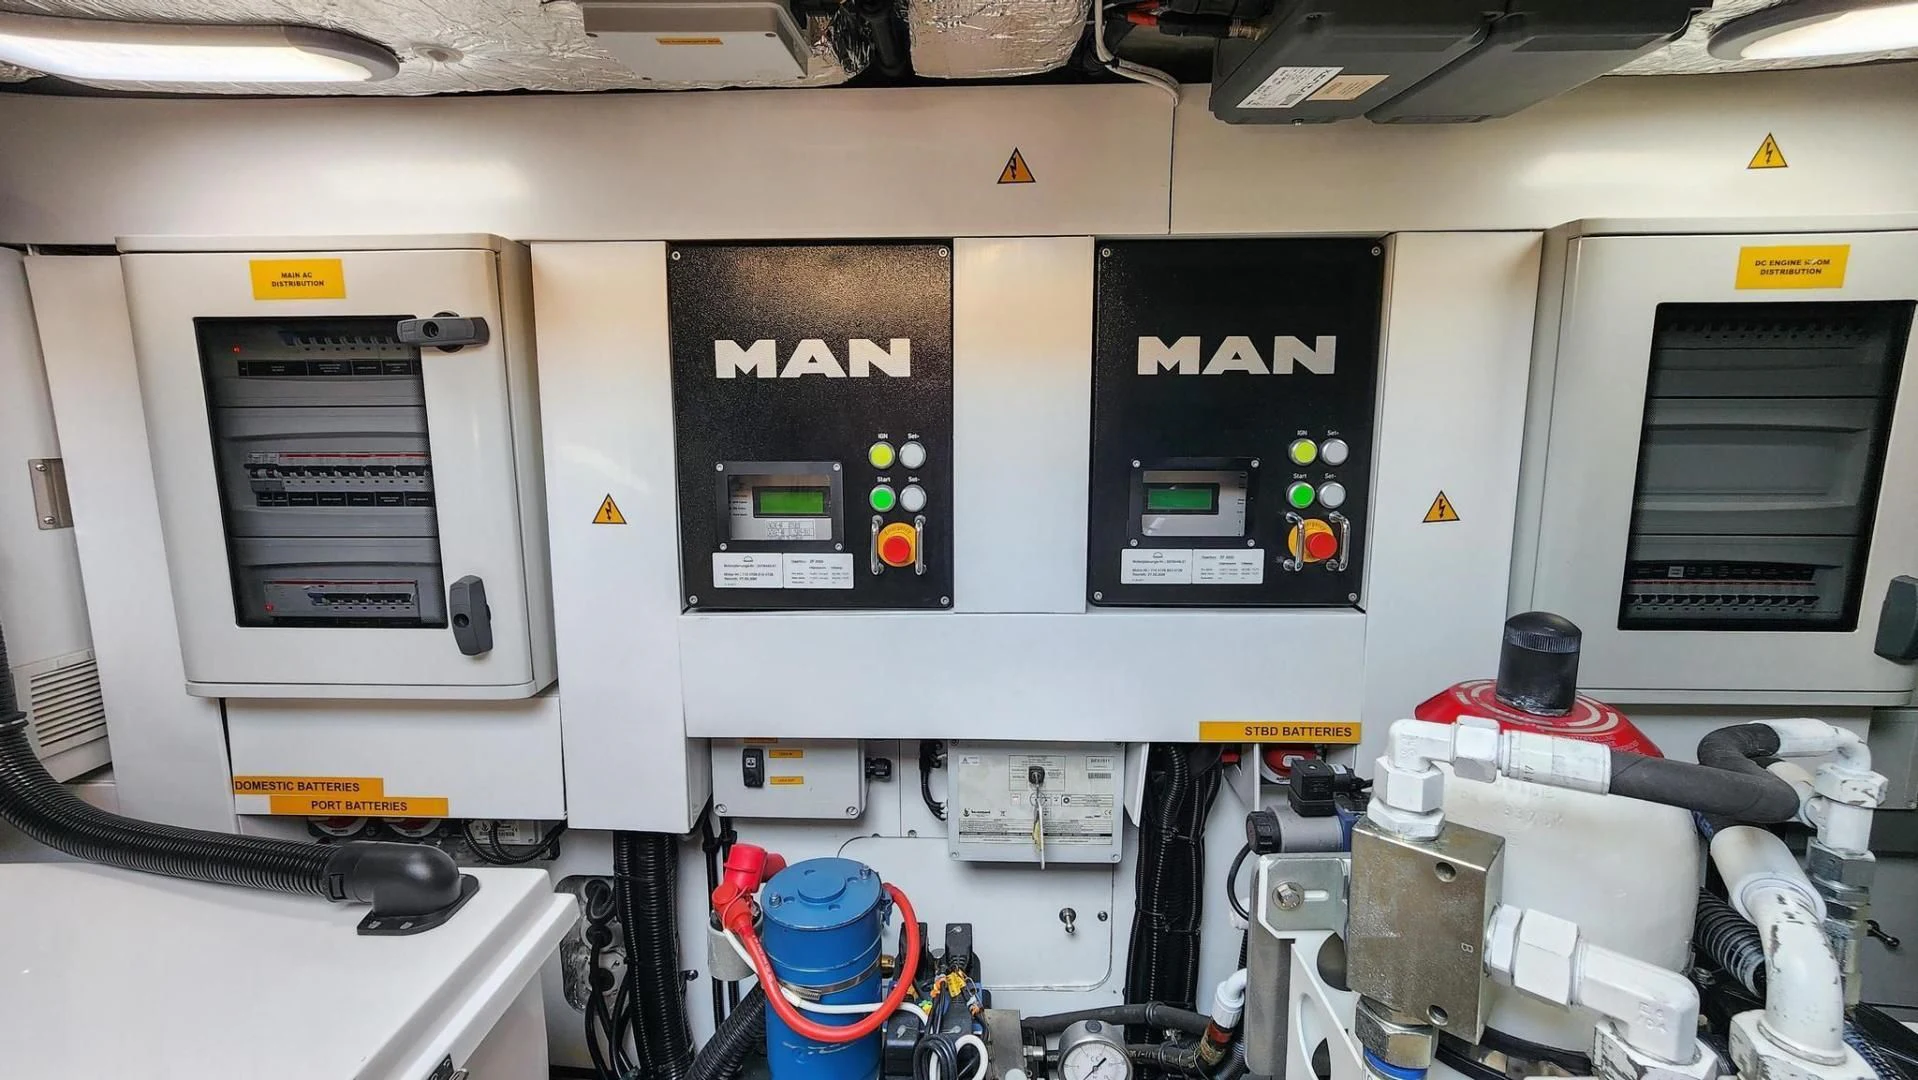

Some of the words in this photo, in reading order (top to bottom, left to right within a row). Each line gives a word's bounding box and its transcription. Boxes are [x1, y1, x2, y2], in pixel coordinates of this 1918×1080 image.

[714, 338, 911, 379] MAN
[1137, 335, 1337, 375] MAN
[1244, 726, 1279, 736] STBD
[1282, 726, 1353, 737] BATTERIES
[235, 780, 295, 791] DOMESTIC
[297, 781, 360, 792] BATTERIES
[311, 800, 342, 810] PORT
[345, 801, 408, 811] BATTERIES
